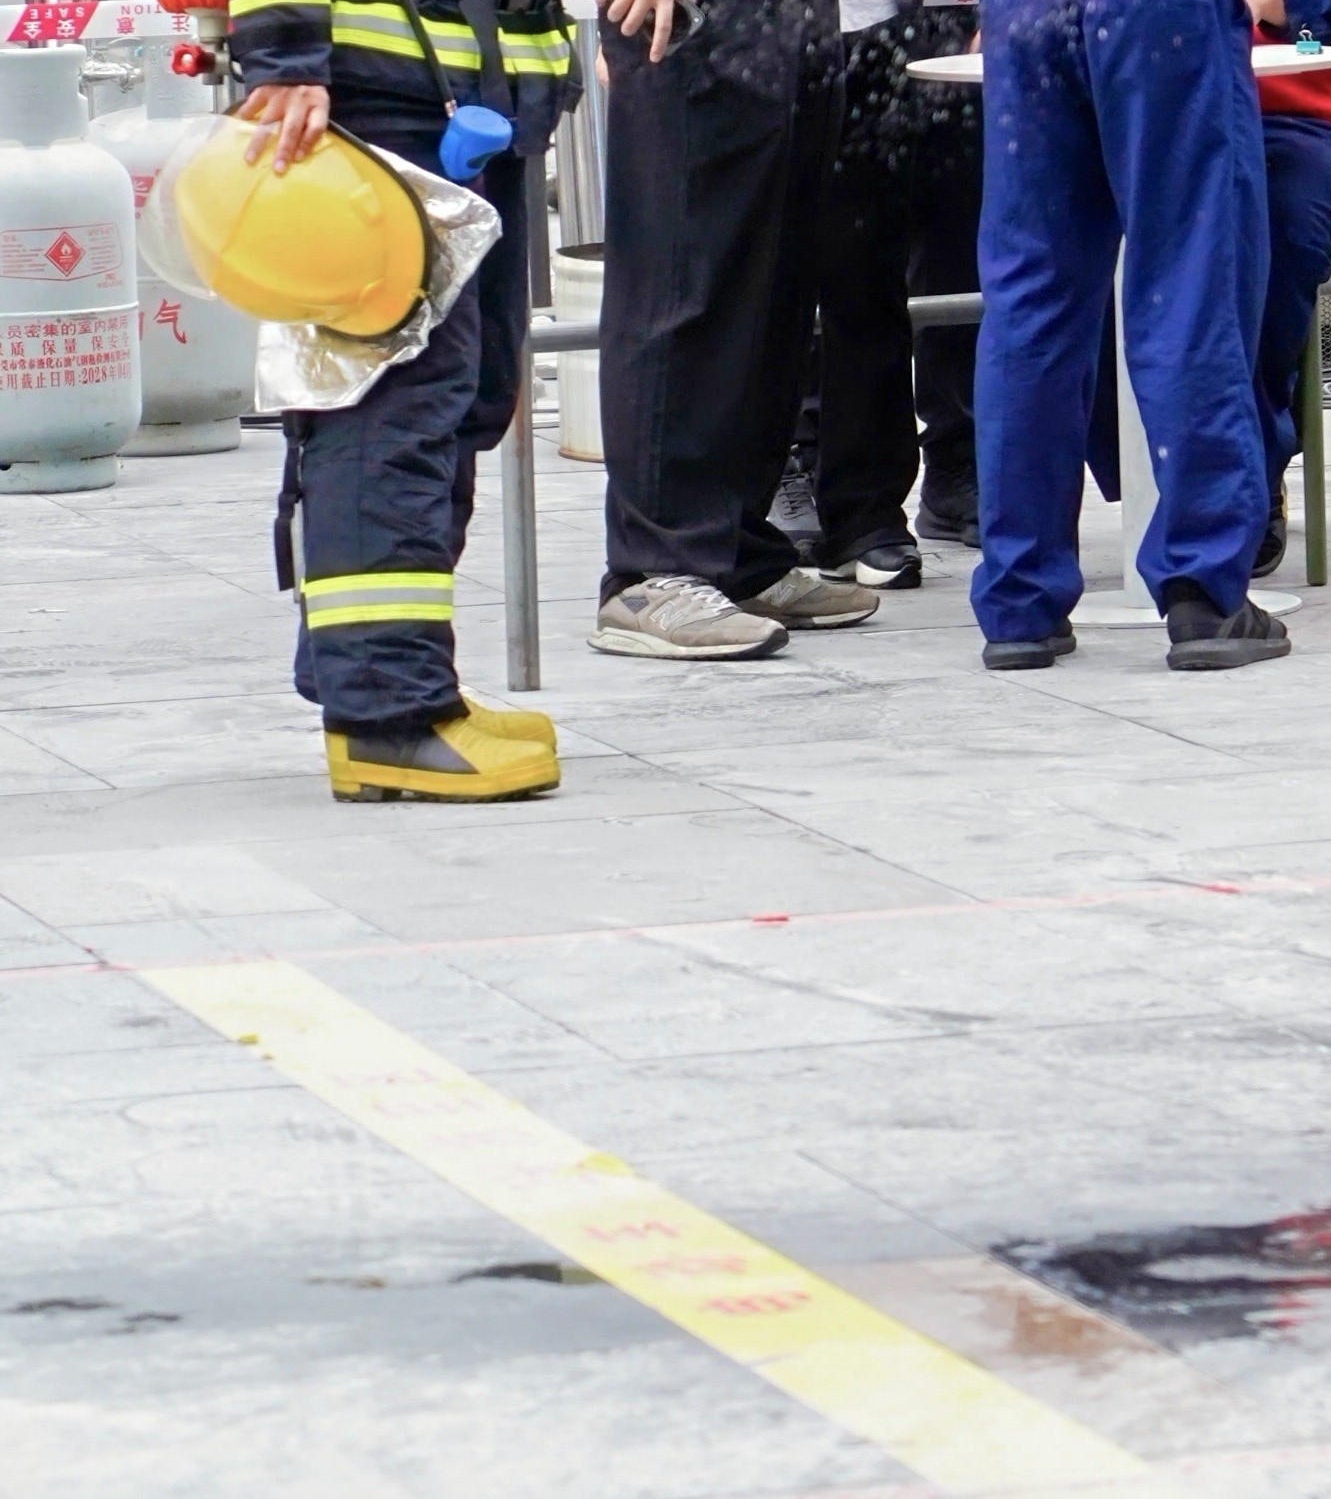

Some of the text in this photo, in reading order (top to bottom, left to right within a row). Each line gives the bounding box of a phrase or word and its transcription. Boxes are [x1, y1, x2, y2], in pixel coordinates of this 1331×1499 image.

[30, 6, 85, 18] SAFE
[121, 3, 163, 16] TION
[23, 18, 77, 38] 安全
[116, 14, 191, 35] 注意
[0, 315, 128, 340] 员密集的室内禁用
